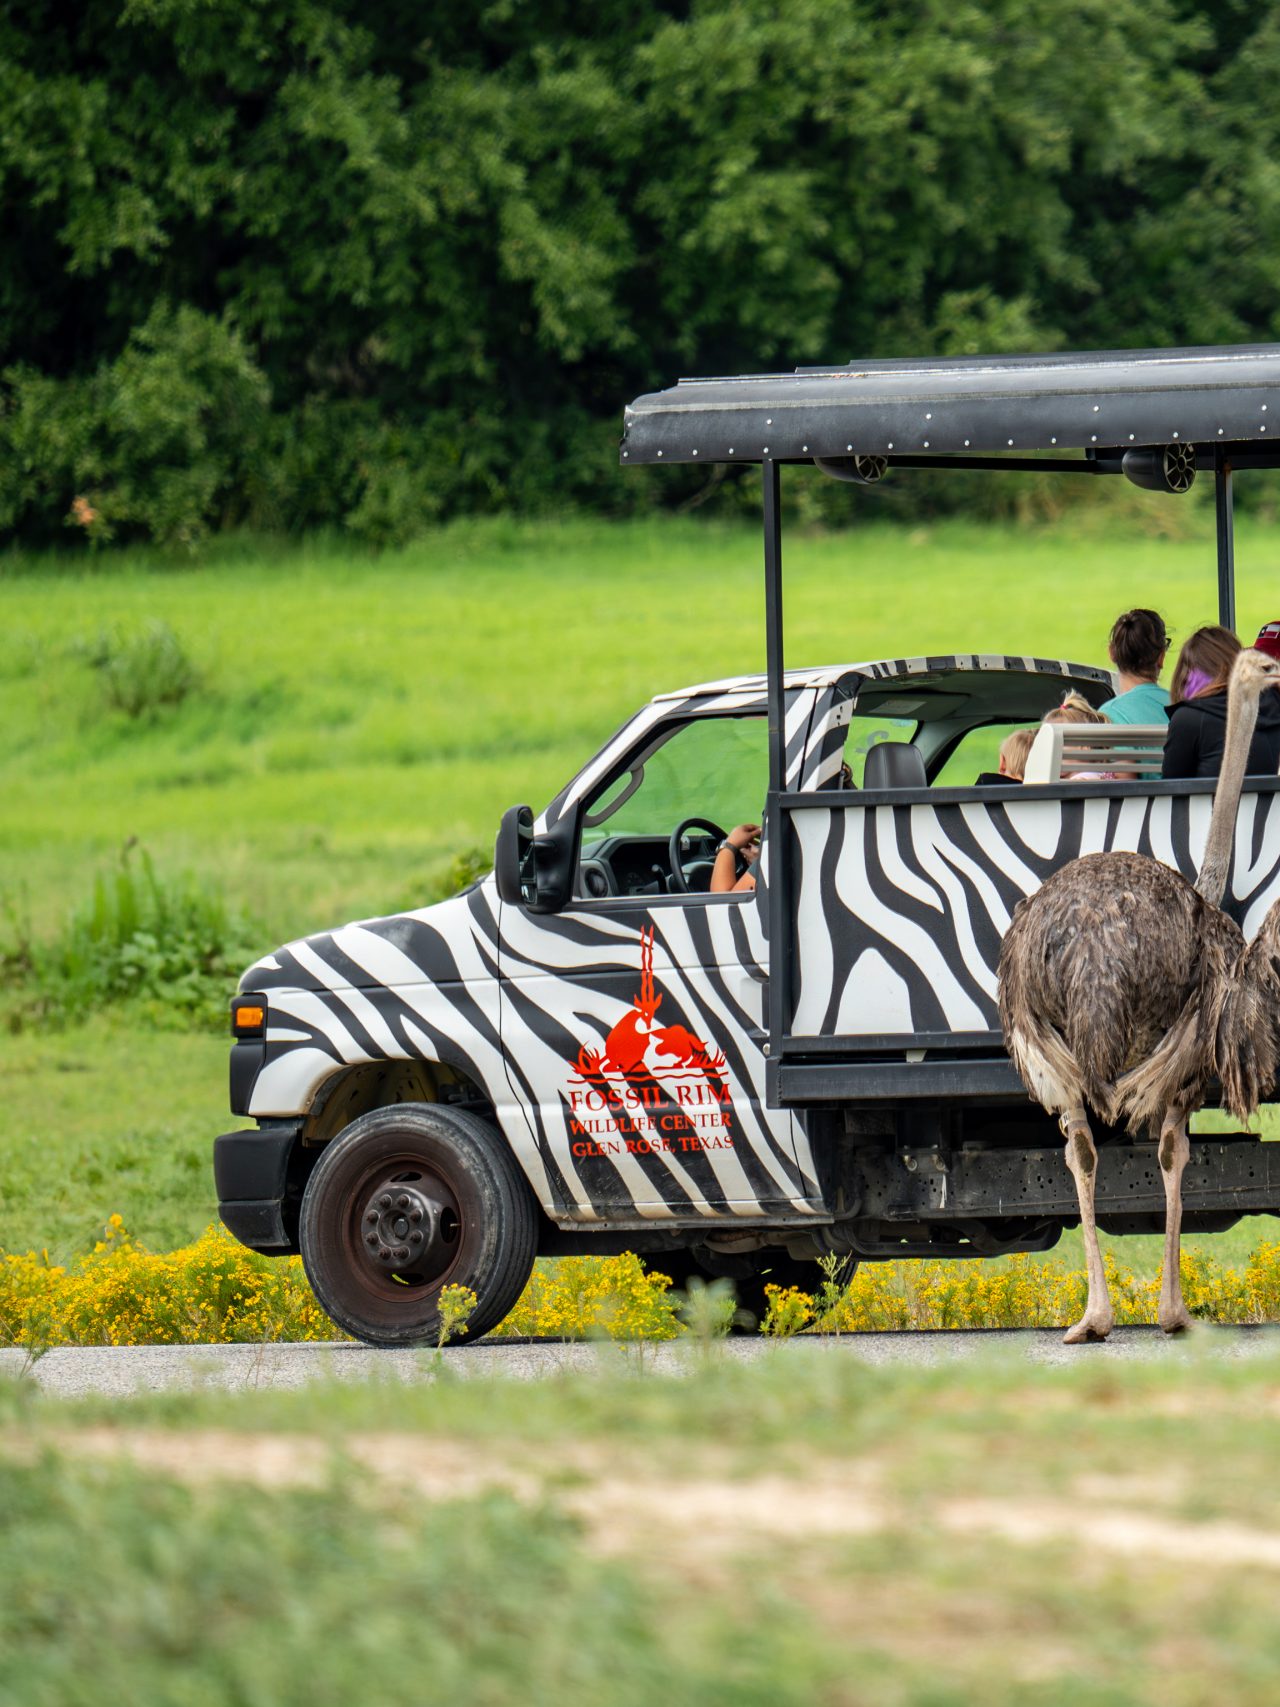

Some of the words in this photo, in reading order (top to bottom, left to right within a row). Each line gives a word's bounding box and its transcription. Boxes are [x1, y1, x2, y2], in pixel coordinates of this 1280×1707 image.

[568, 1086, 669, 1113] FOSSIL
[675, 1083, 733, 1107] RIM
[569, 1115, 657, 1136] WILDLIFE
[660, 1112, 733, 1130] CENTER
[572, 1141, 620, 1158] GLEN
[625, 1138, 676, 1154] ROSE,
[678, 1135, 735, 1151] TEXAS
